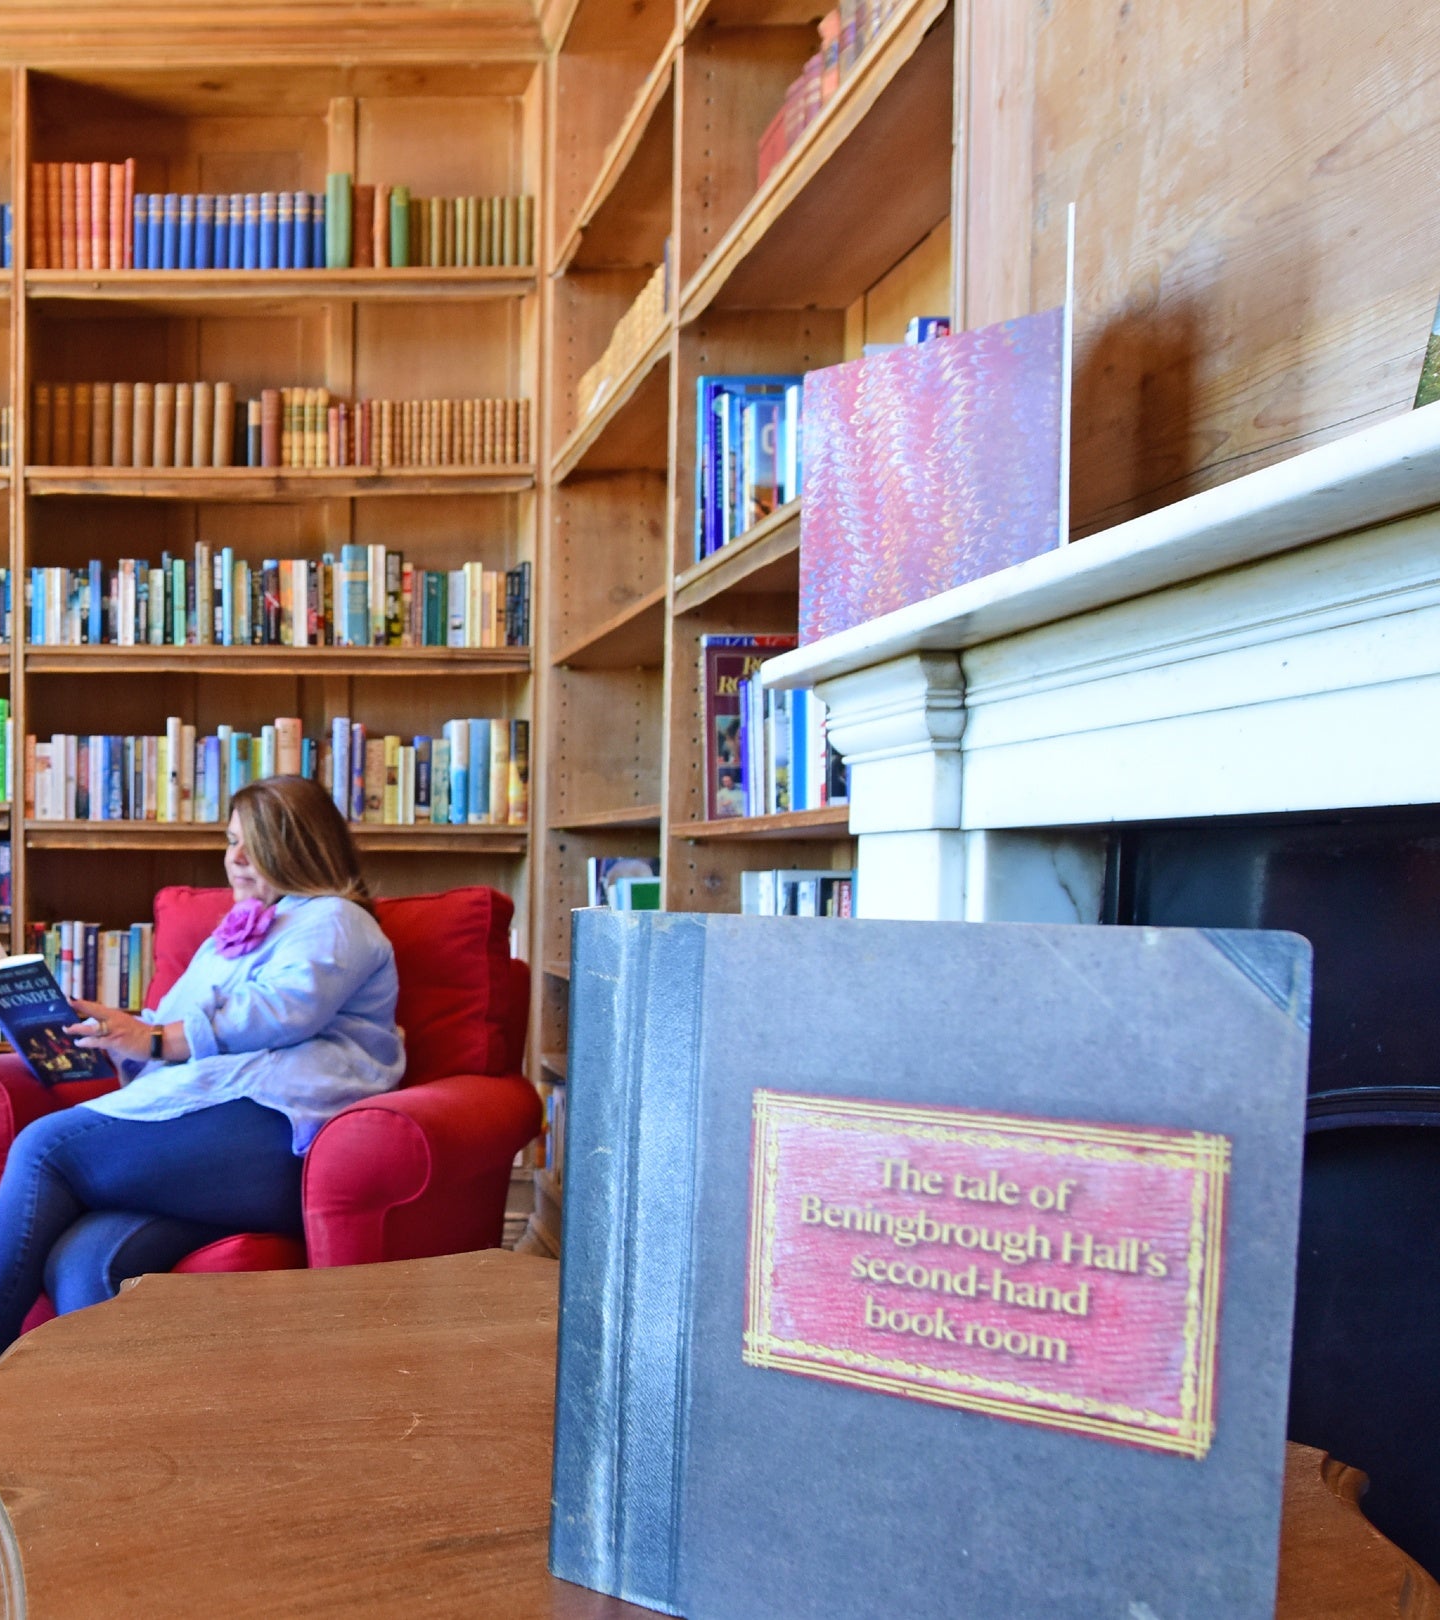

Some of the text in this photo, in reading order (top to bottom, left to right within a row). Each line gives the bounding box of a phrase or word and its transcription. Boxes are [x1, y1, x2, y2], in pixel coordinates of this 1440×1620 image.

[14, 980, 33, 990] AGE
[878, 1157, 1078, 1211] The tale of
[799, 1196, 1169, 1278] Beningbrough Hall's
[850, 1252, 1090, 1316] second-hand
[864, 1296, 1068, 1363] book room
